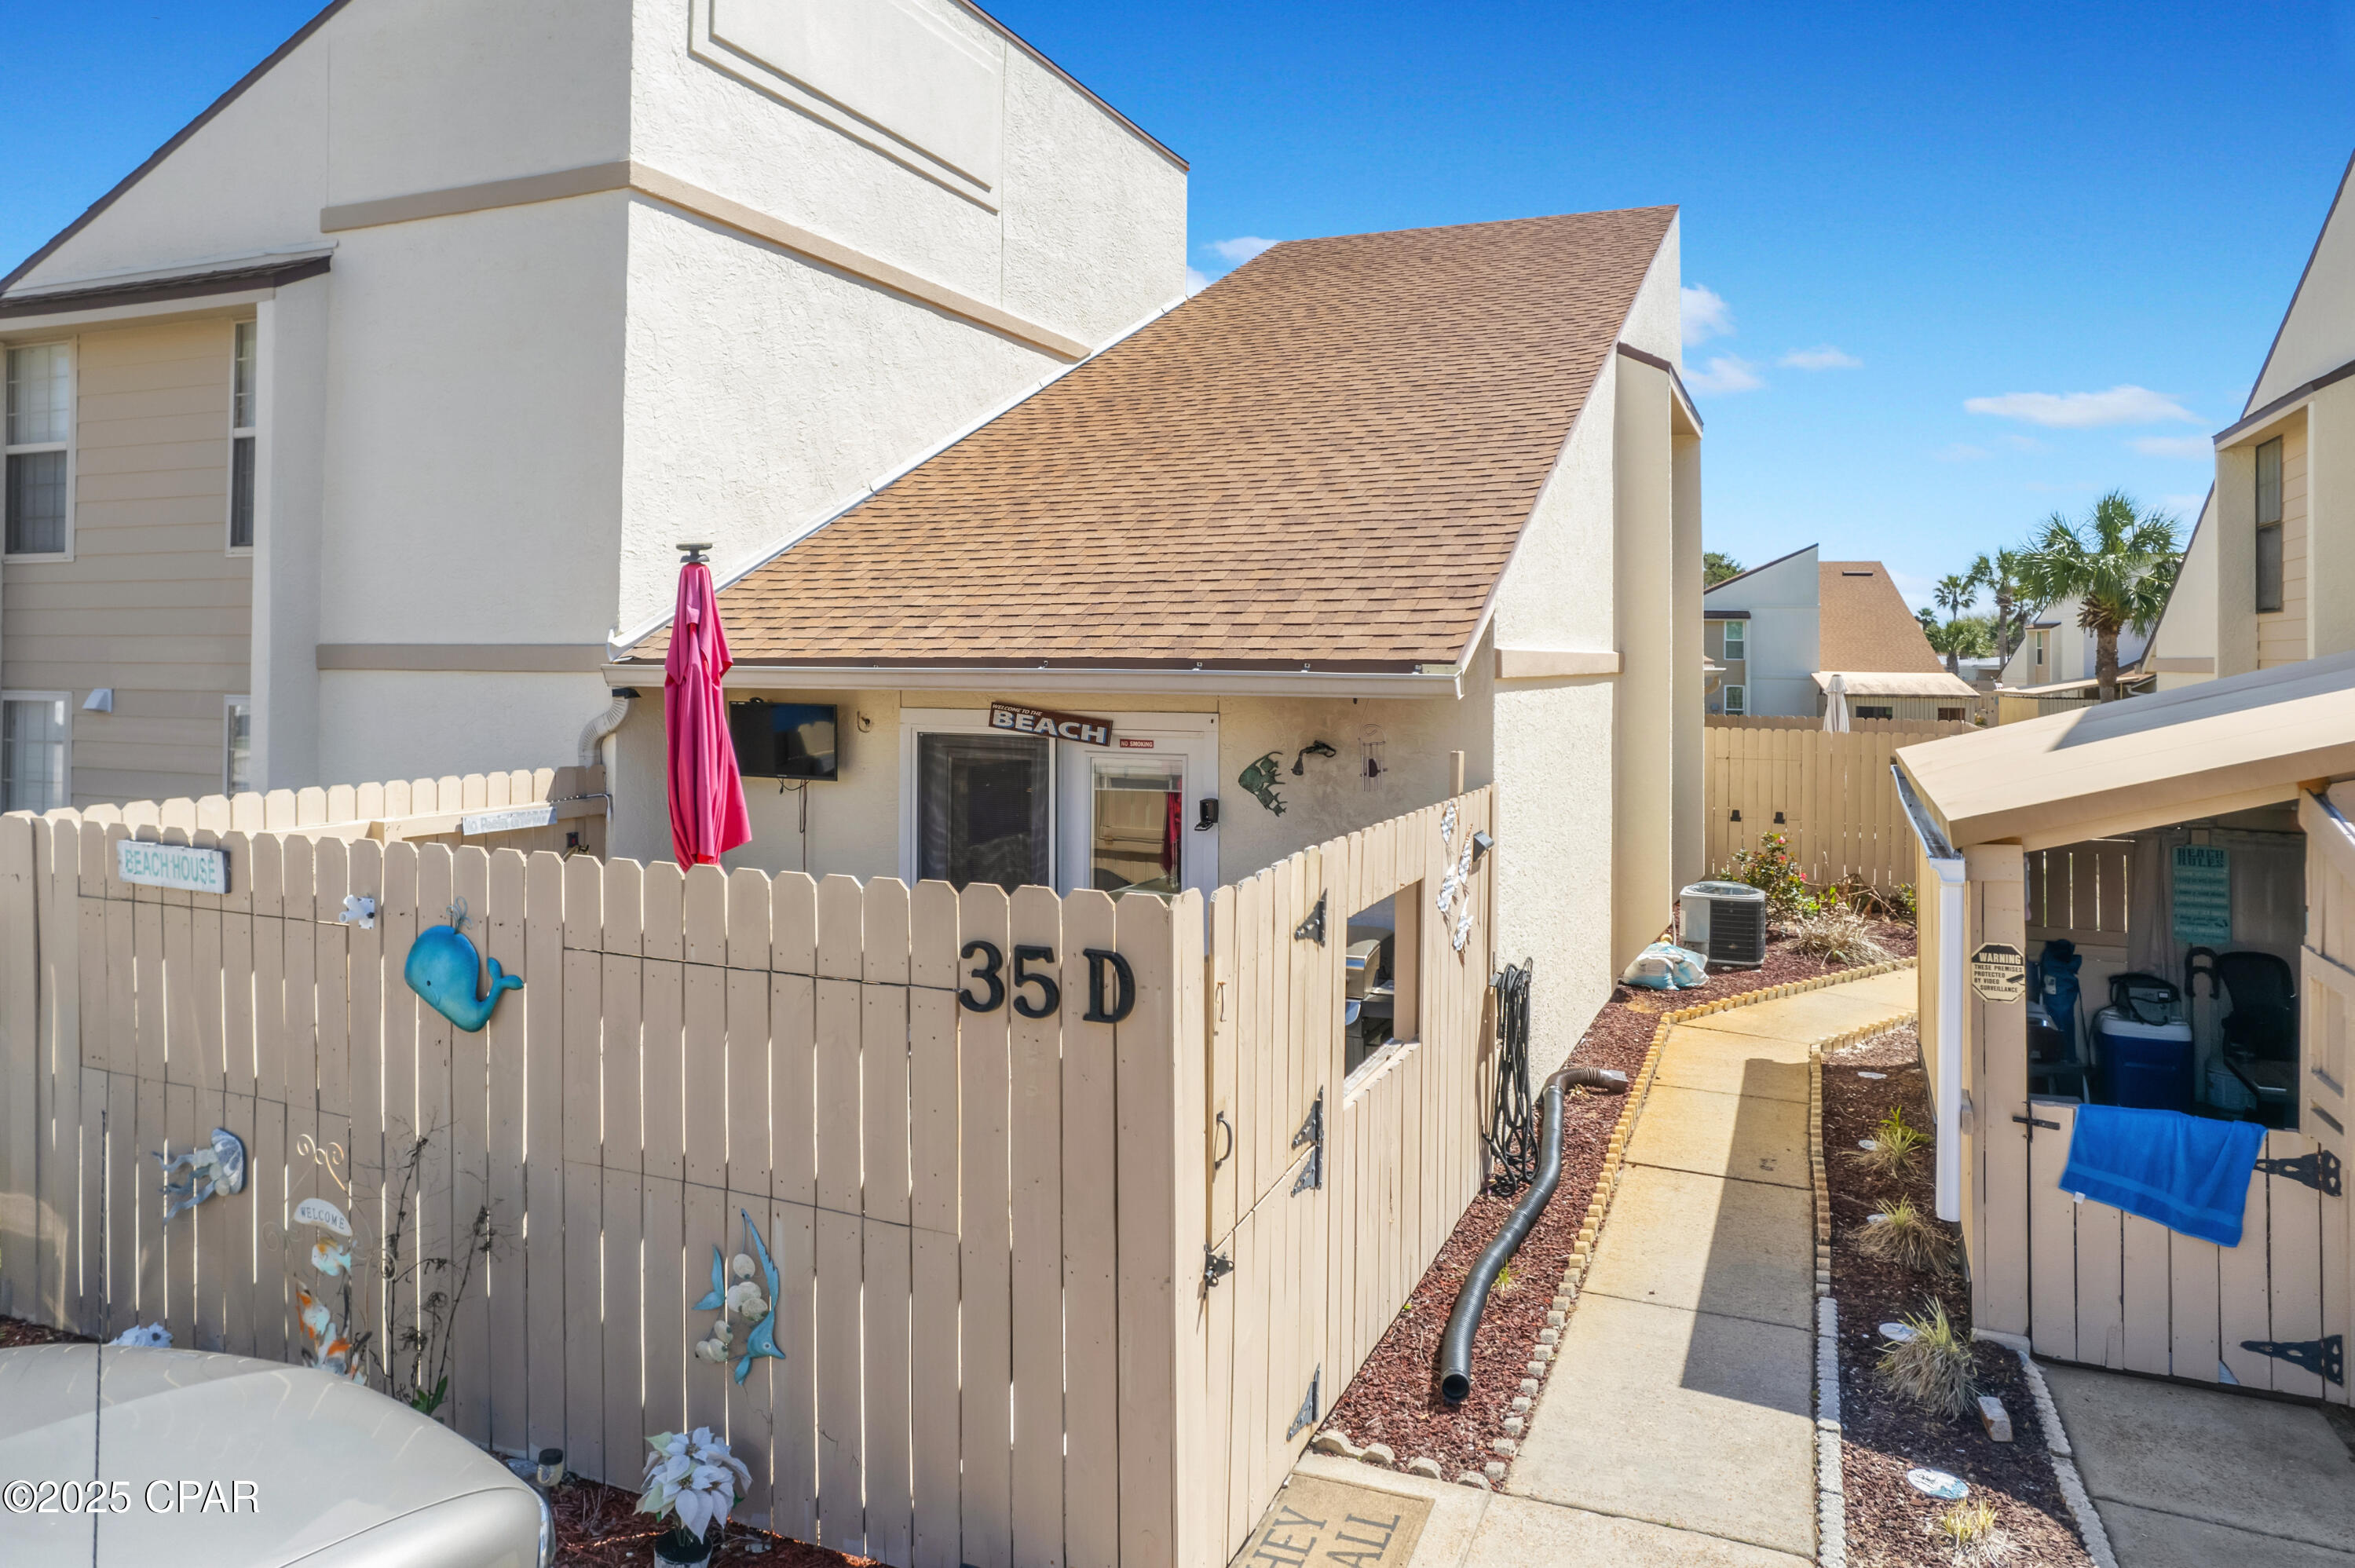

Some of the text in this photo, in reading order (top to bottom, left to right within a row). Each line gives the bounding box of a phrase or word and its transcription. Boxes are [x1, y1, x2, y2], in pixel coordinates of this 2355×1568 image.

[993, 704, 1021, 714] WELCOME
[993, 709, 1107, 744] BEACH
[126, 849, 217, 884] BEACH HOUSE
[1979, 952, 2021, 965] WARNING
[959, 941, 1136, 1024] 35 D
[1980, 985, 2019, 993] SURVEILLANCE
[301, 1206, 345, 1230] WELCOME
